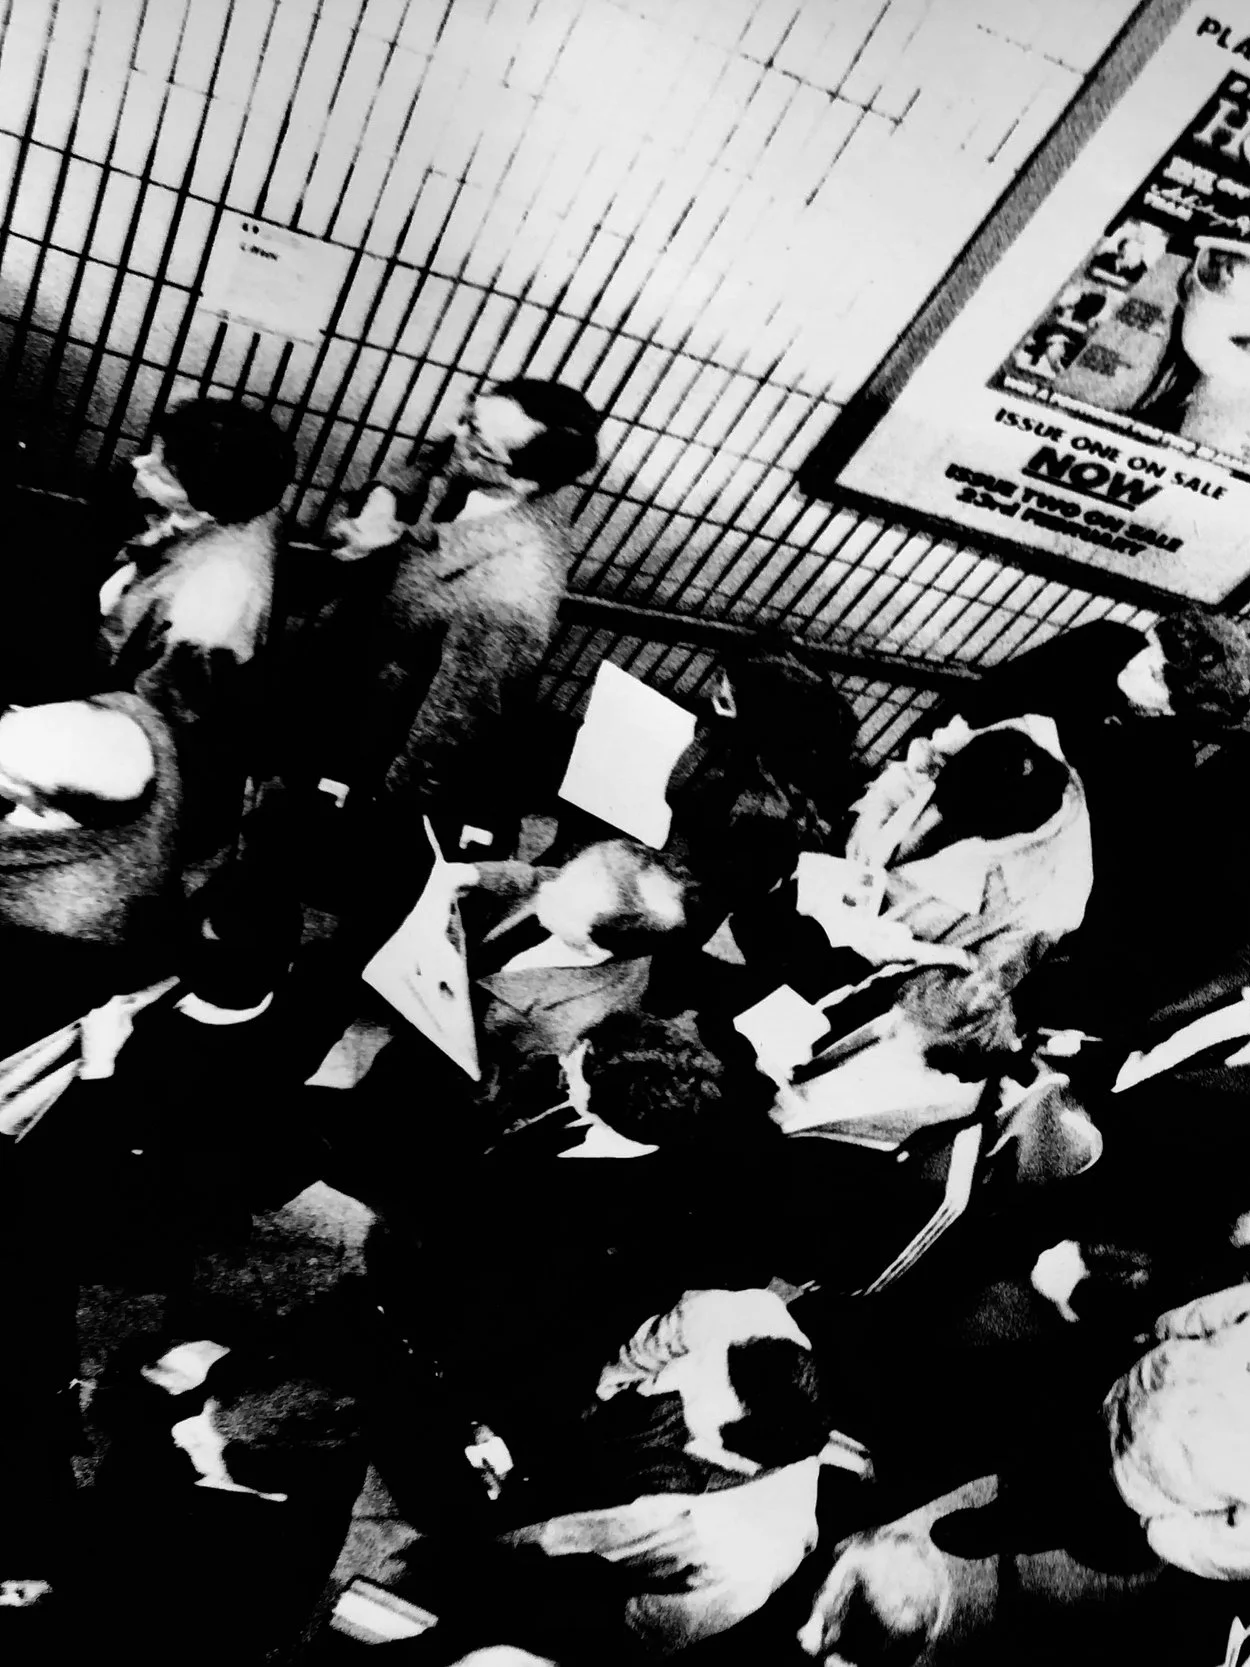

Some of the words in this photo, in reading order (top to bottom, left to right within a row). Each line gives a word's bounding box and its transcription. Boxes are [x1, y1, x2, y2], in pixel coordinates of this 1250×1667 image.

[994, 407, 1065, 443] ISSUE
[1071, 435, 1123, 464] ONE
[1127, 456, 1166, 480] ON
[1170, 471, 1228, 501] SALE
[1025, 445, 1163, 506] NOW
[944, 463, 1019, 497] ISSUE
[1021, 486, 1082, 519] TWO
[1083, 509, 1127, 533] ON
[1124, 523, 1184, 554] SALE
